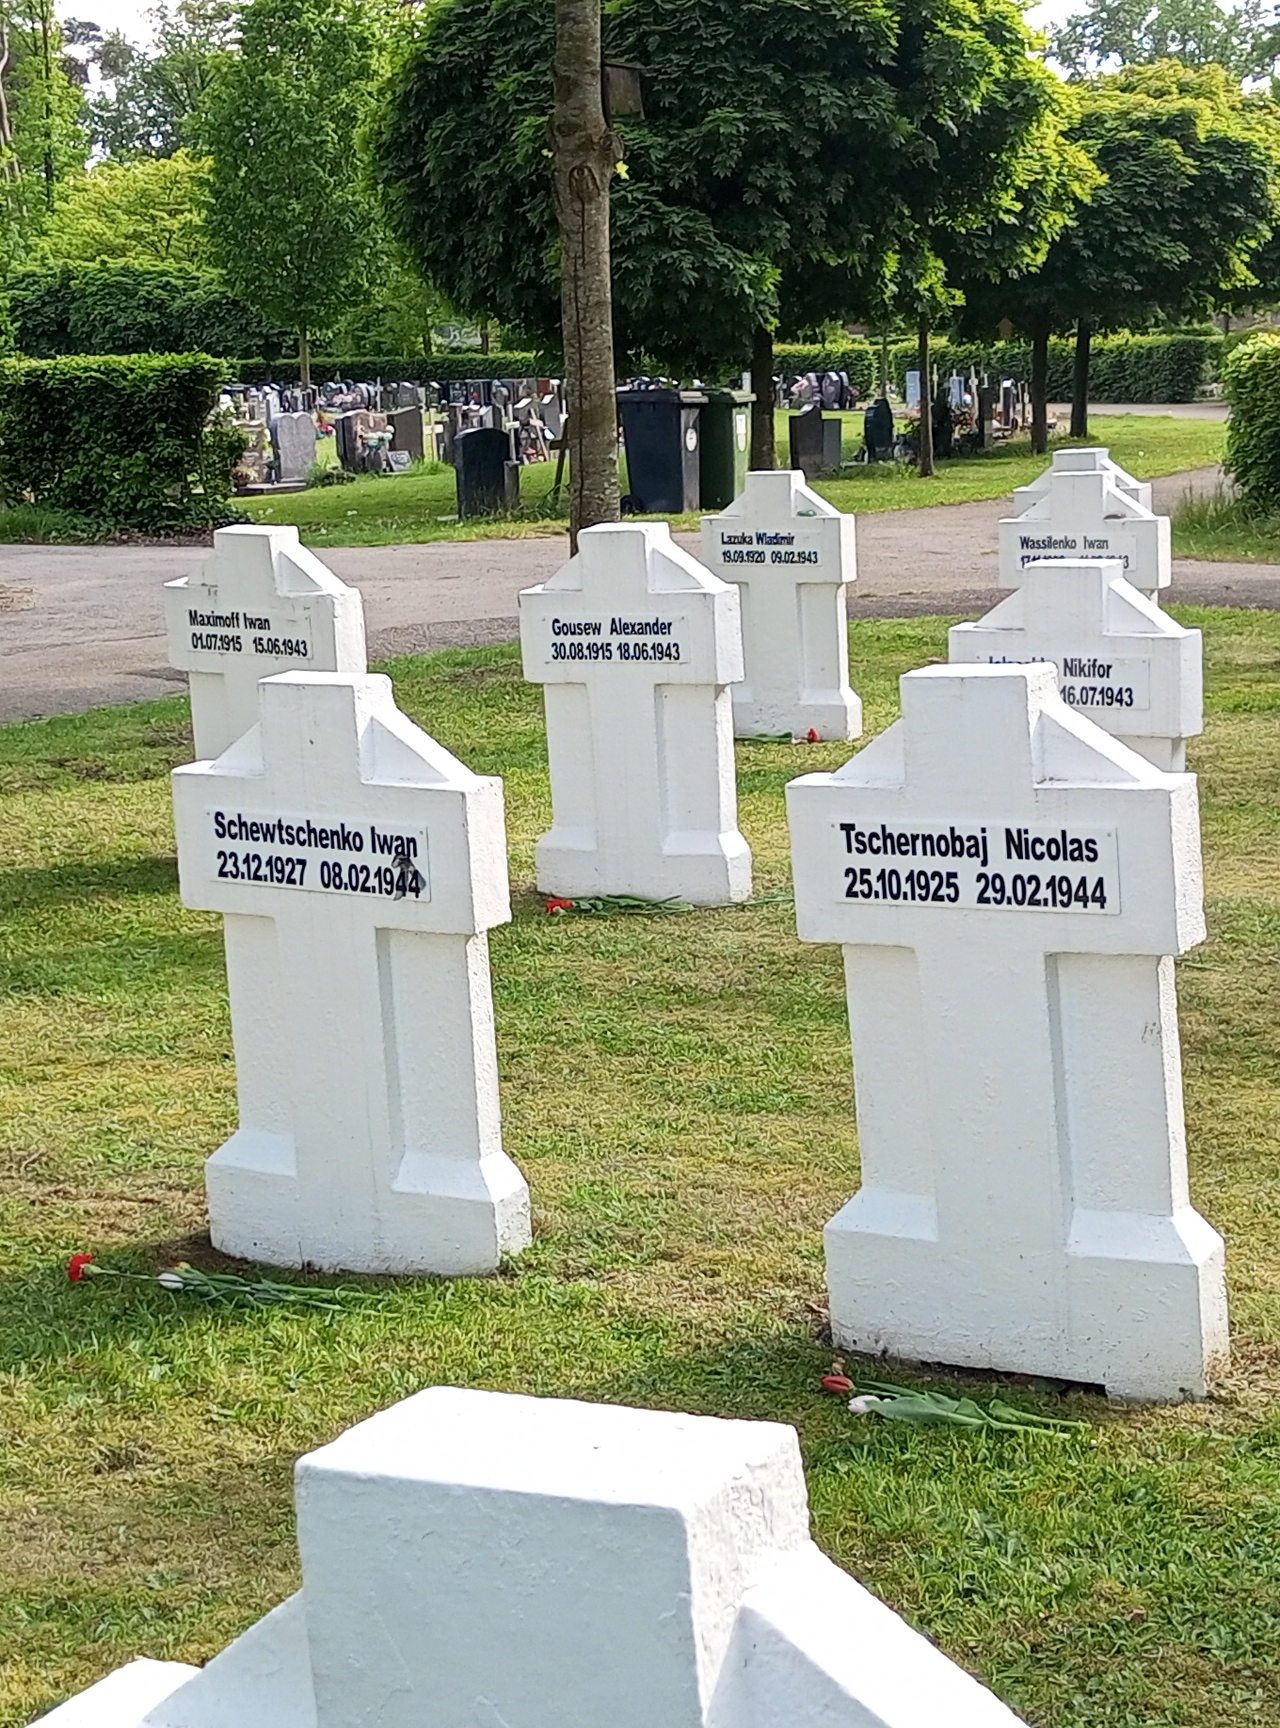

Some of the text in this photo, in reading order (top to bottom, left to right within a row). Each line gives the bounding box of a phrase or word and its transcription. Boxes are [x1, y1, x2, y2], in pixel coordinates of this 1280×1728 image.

[721, 531, 795, 545] Lazuka Wladimir
[1019, 535, 1109, 550] Wassilenko Iwan
[770, 551, 818, 564] 09.02.1943
[188, 609, 271, 631] Maximoff Iwan
[552, 616, 673, 636] Gousew Alexander
[191, 632, 308, 657] 01.07.1915 15.06.1943
[551, 642, 680, 661] 30.08.1915 18.06.1943
[1063, 657, 1113, 679] Nikifor
[214, 811, 418, 858] Schewtschenko Iwan
[840, 823, 1099, 867] Tschernobaj Nicolas
[216, 850, 421, 899] 23.12.1927 08.02.1944
[844, 867, 1107, 909] 25.10.1925 29.02.1944
